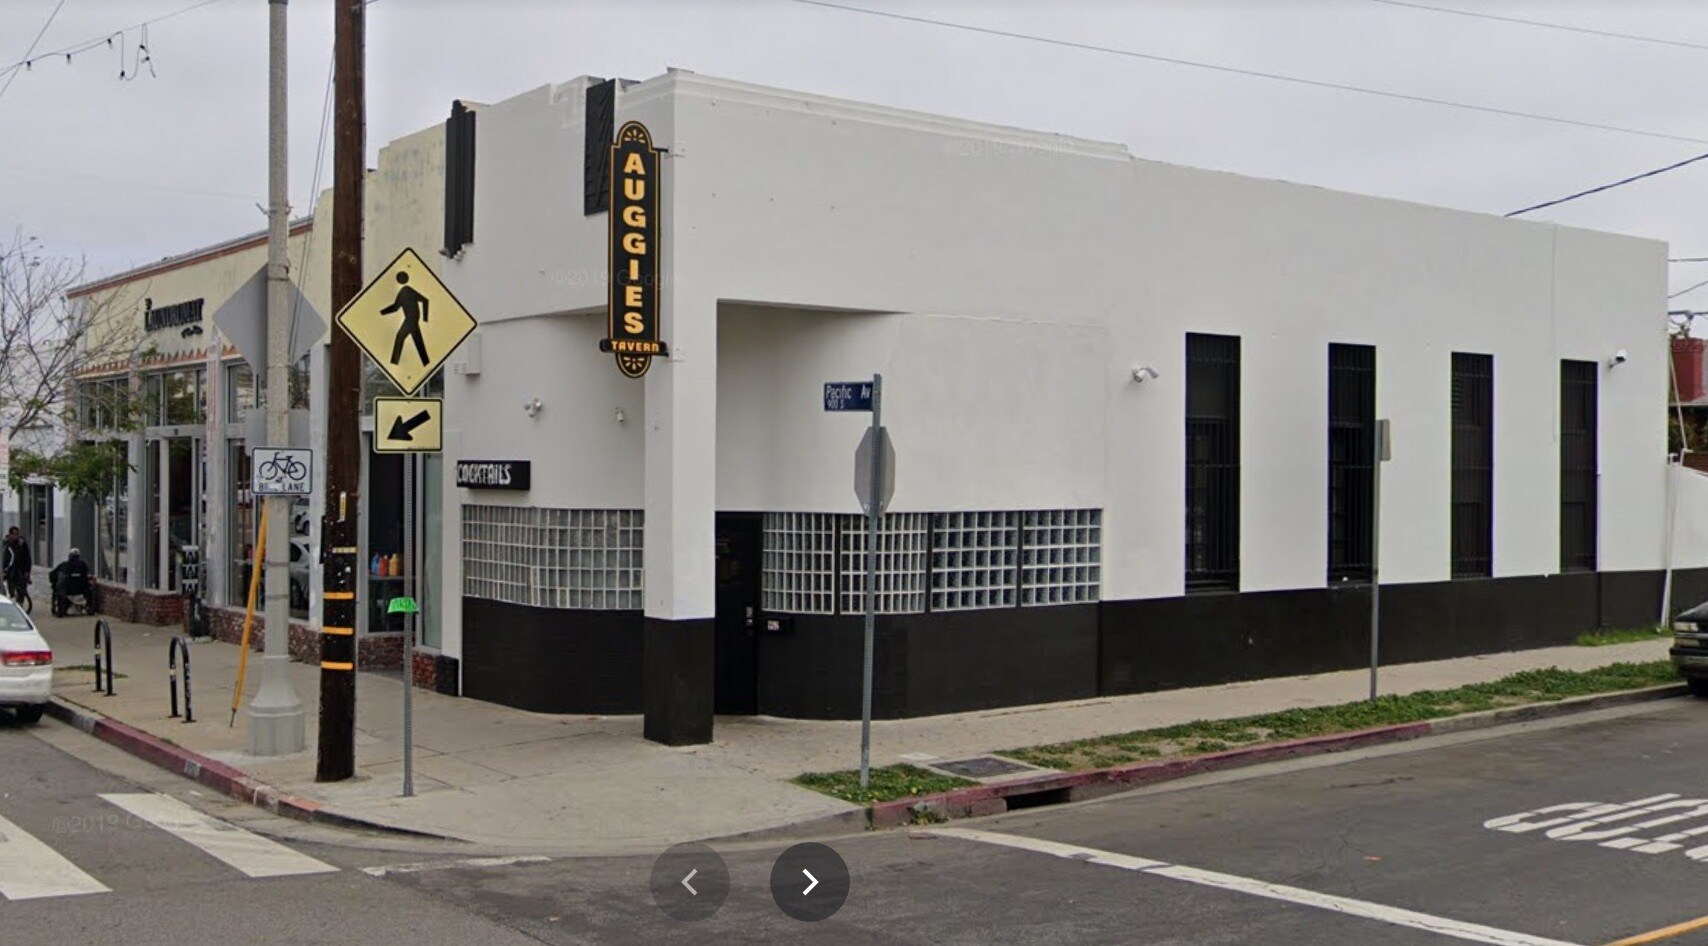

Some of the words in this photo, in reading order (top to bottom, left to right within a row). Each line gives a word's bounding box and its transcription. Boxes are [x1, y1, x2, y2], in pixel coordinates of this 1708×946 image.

[622, 153, 647, 334] AUGGIES
[611, 340, 660, 353] TAVERN
[826, 385, 851, 399] Pacific
[282, 482, 305, 492] LANE
